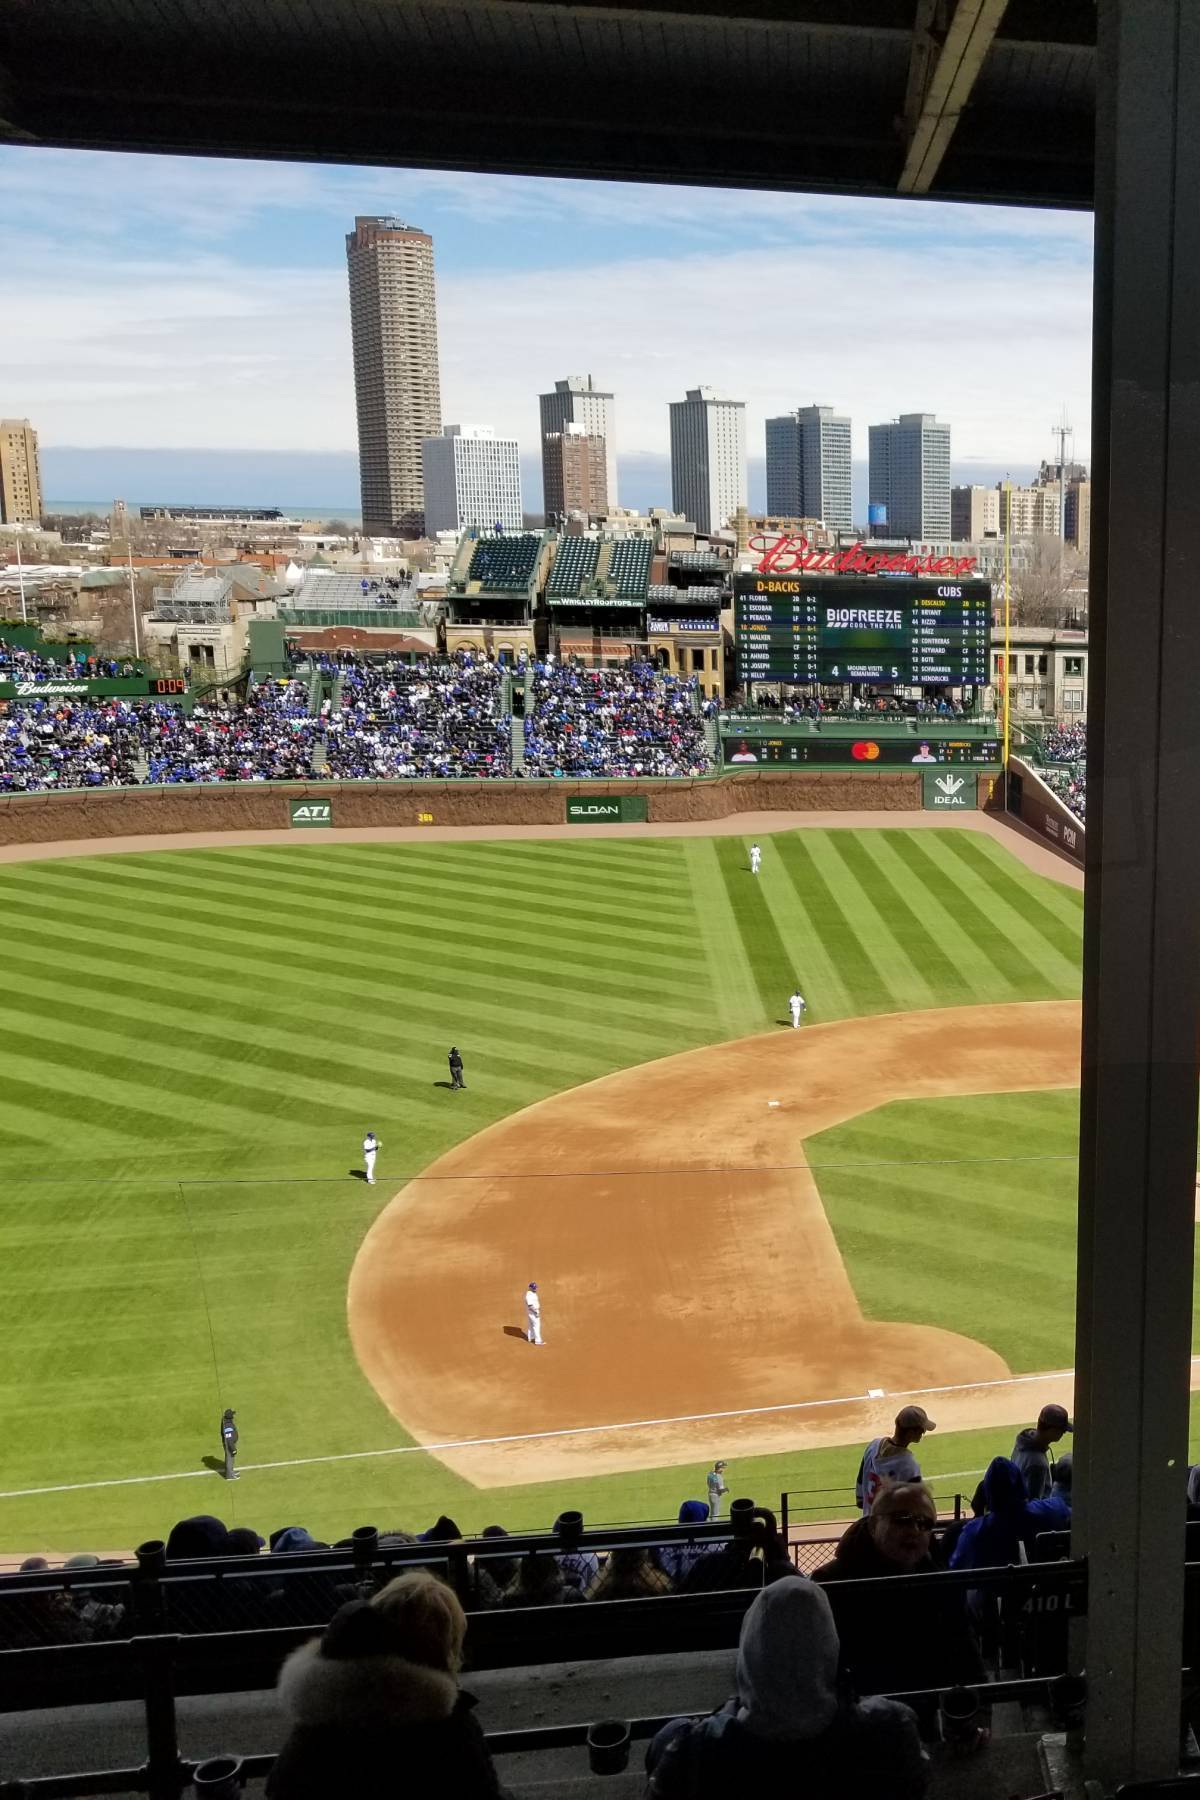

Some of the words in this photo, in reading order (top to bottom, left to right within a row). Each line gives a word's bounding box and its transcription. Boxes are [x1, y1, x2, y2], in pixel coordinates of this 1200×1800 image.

[748, 535, 977, 574] Budweiser
[757, 581, 799, 592] D-BACKS
[938, 587, 961, 596] CUBS
[832, 666, 839, 676] 4
[892, 667, 898, 677] 5
[15, 680, 88, 695] Budweiser
[293, 806, 330, 816] ATI
[570, 806, 618, 814] SLOAN
[1022, 1594, 1058, 1614] 410
